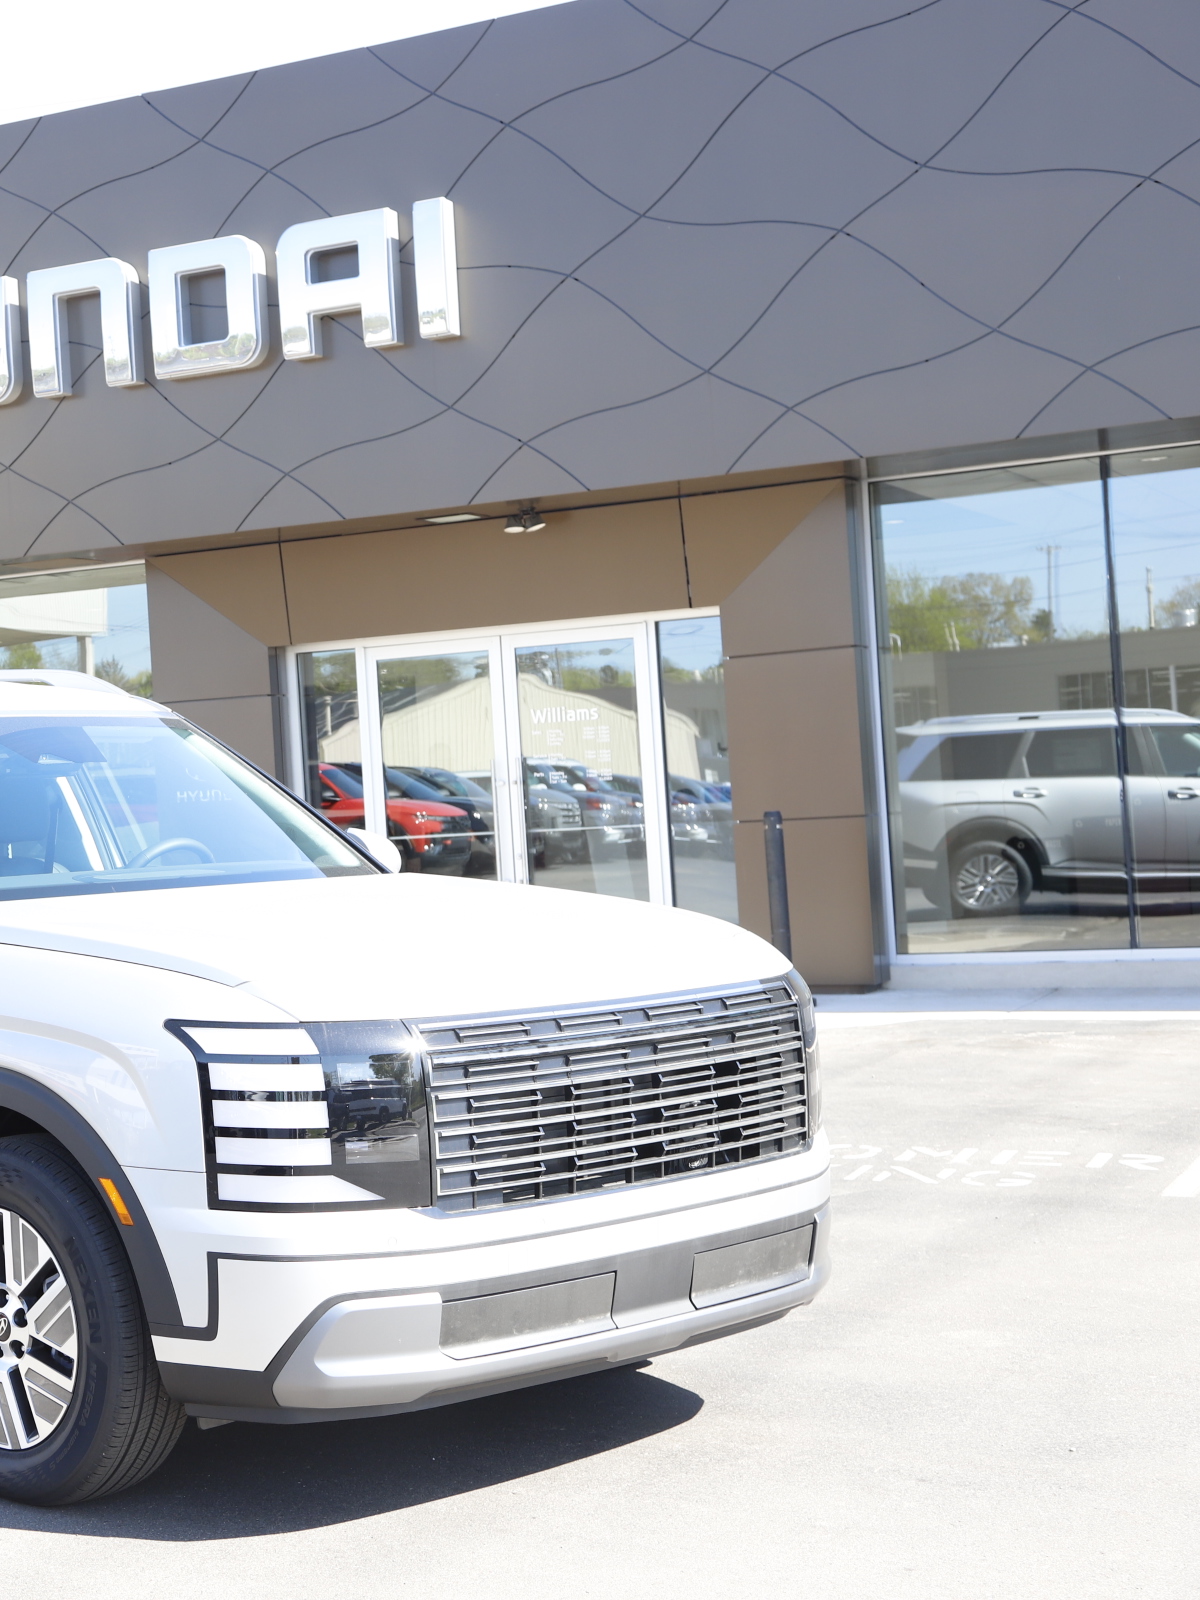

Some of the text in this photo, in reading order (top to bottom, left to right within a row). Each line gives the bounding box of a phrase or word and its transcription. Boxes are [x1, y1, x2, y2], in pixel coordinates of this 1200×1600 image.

[530, 706, 599, 724] Williams
[829, 1143, 1166, 1171] OMER
[830, 1164, 1037, 1188] ING
[63, 1237, 103, 1344] NEXEN
